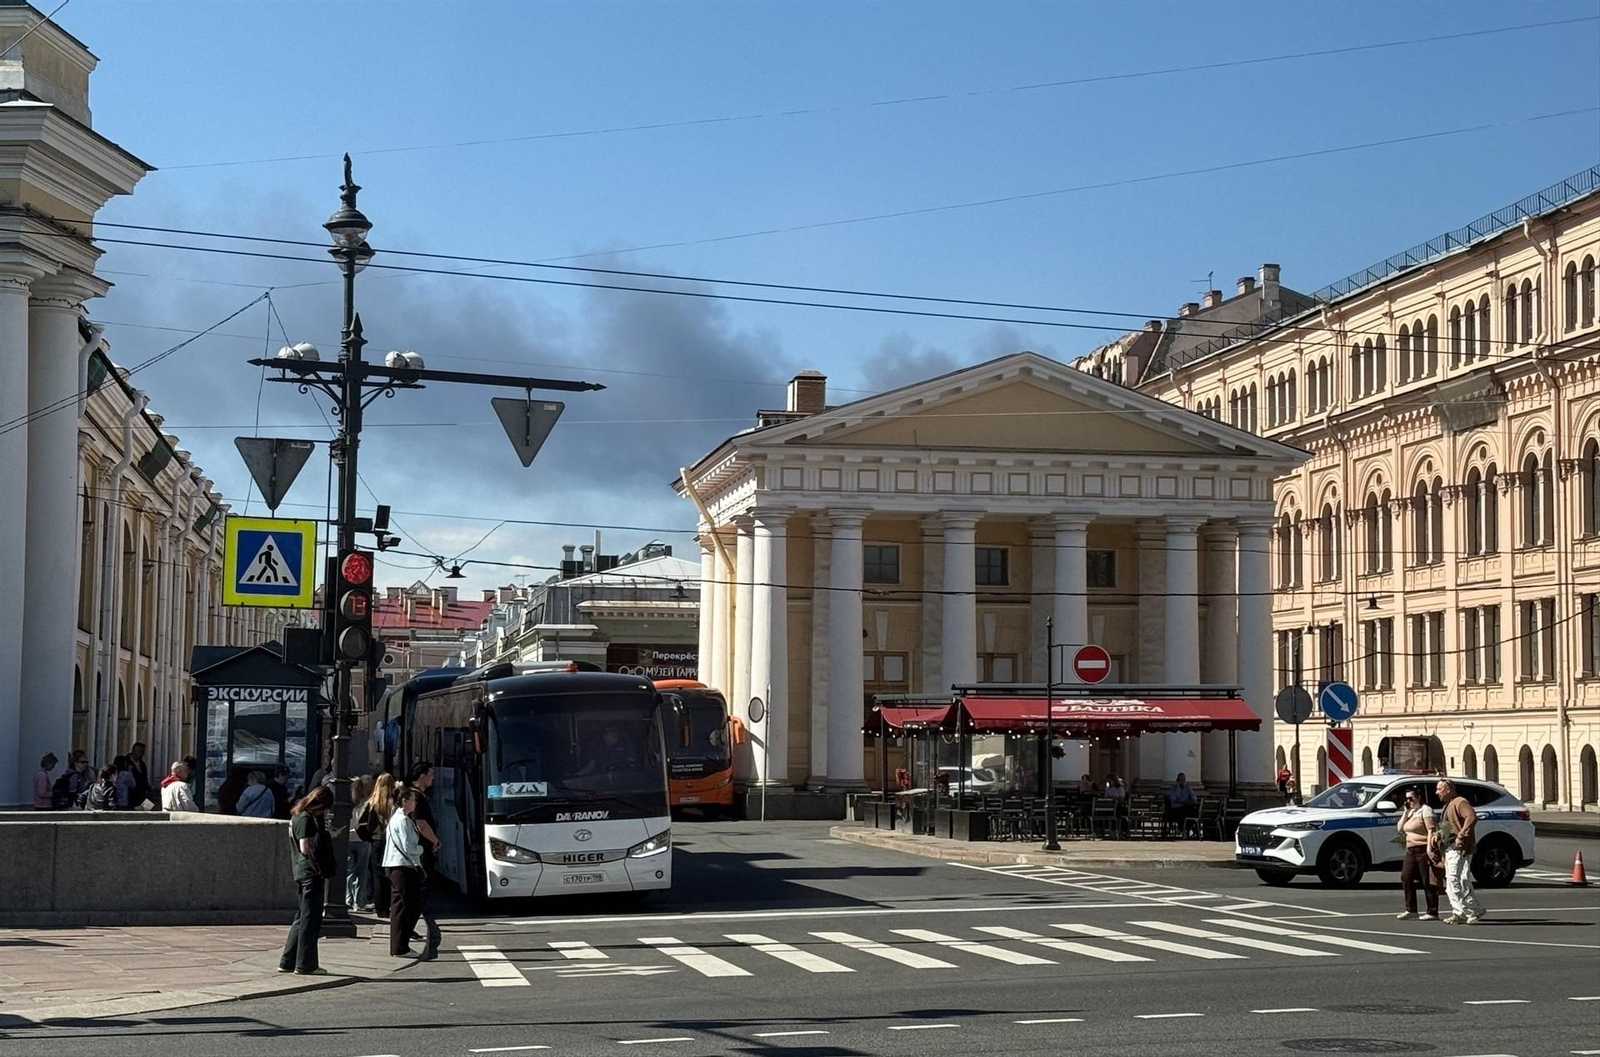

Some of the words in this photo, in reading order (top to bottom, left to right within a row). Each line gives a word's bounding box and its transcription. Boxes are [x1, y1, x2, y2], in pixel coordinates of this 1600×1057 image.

[652, 651, 698, 661] Перекрёс
[207, 687, 309, 702] ЭКСКУРСИИ
[1069, 704, 1165, 714] БАЛТИКА
[555, 811, 610, 822] DAVRANOV
[563, 853, 605, 863] HIGER
